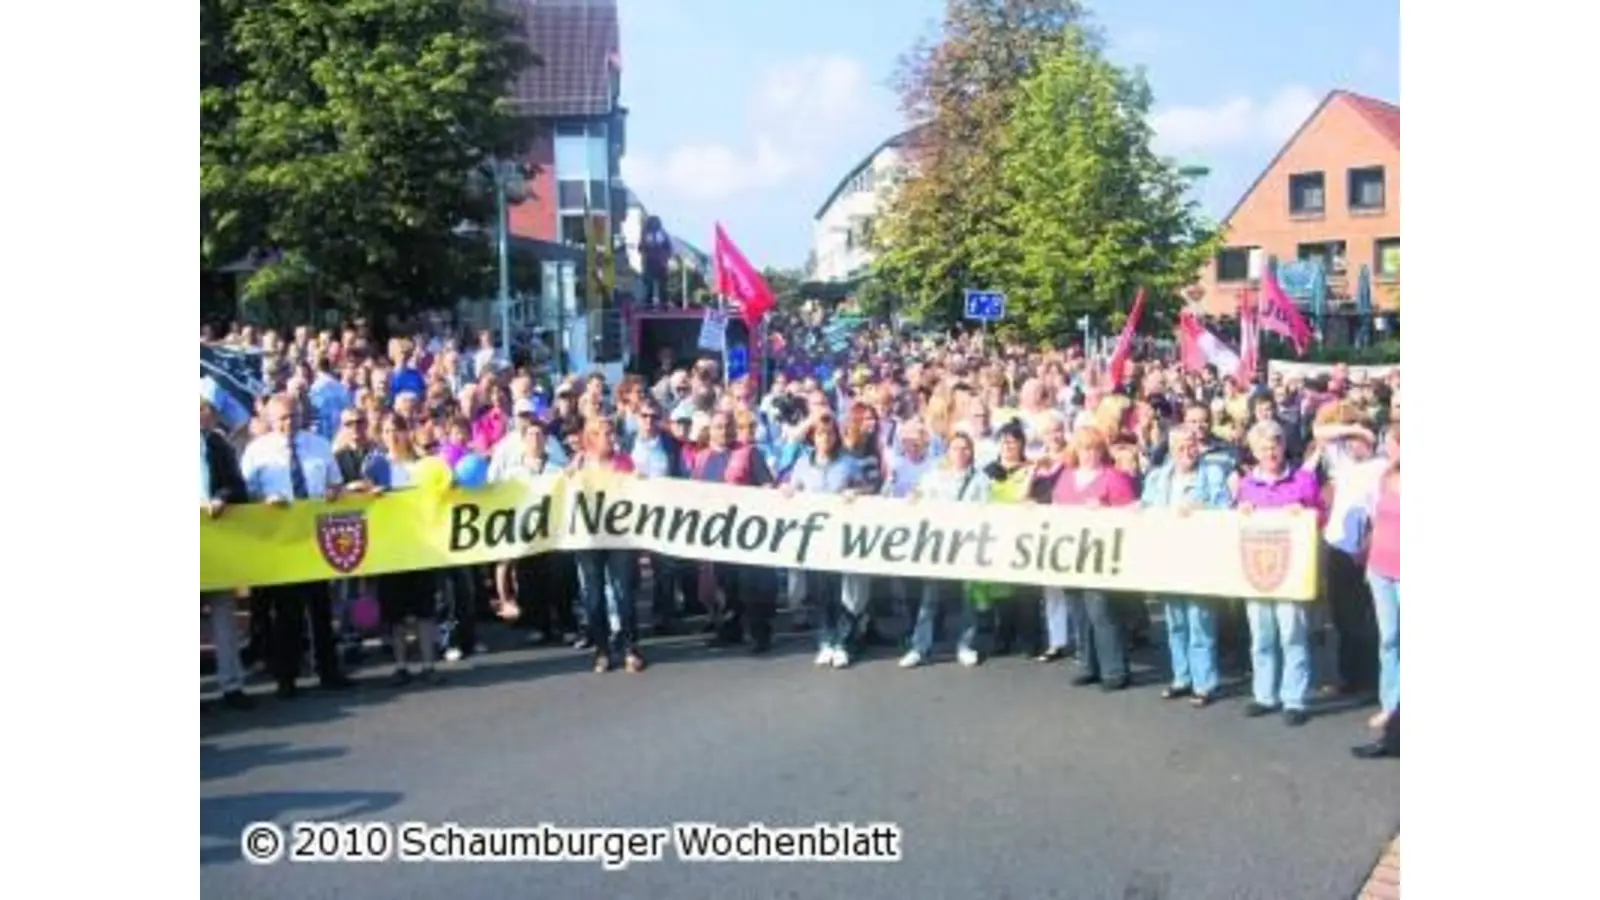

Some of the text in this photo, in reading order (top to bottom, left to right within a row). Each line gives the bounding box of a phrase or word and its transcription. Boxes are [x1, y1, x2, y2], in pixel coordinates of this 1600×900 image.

[449, 490, 1125, 576] Bad Nenndorf wehrt sich!
